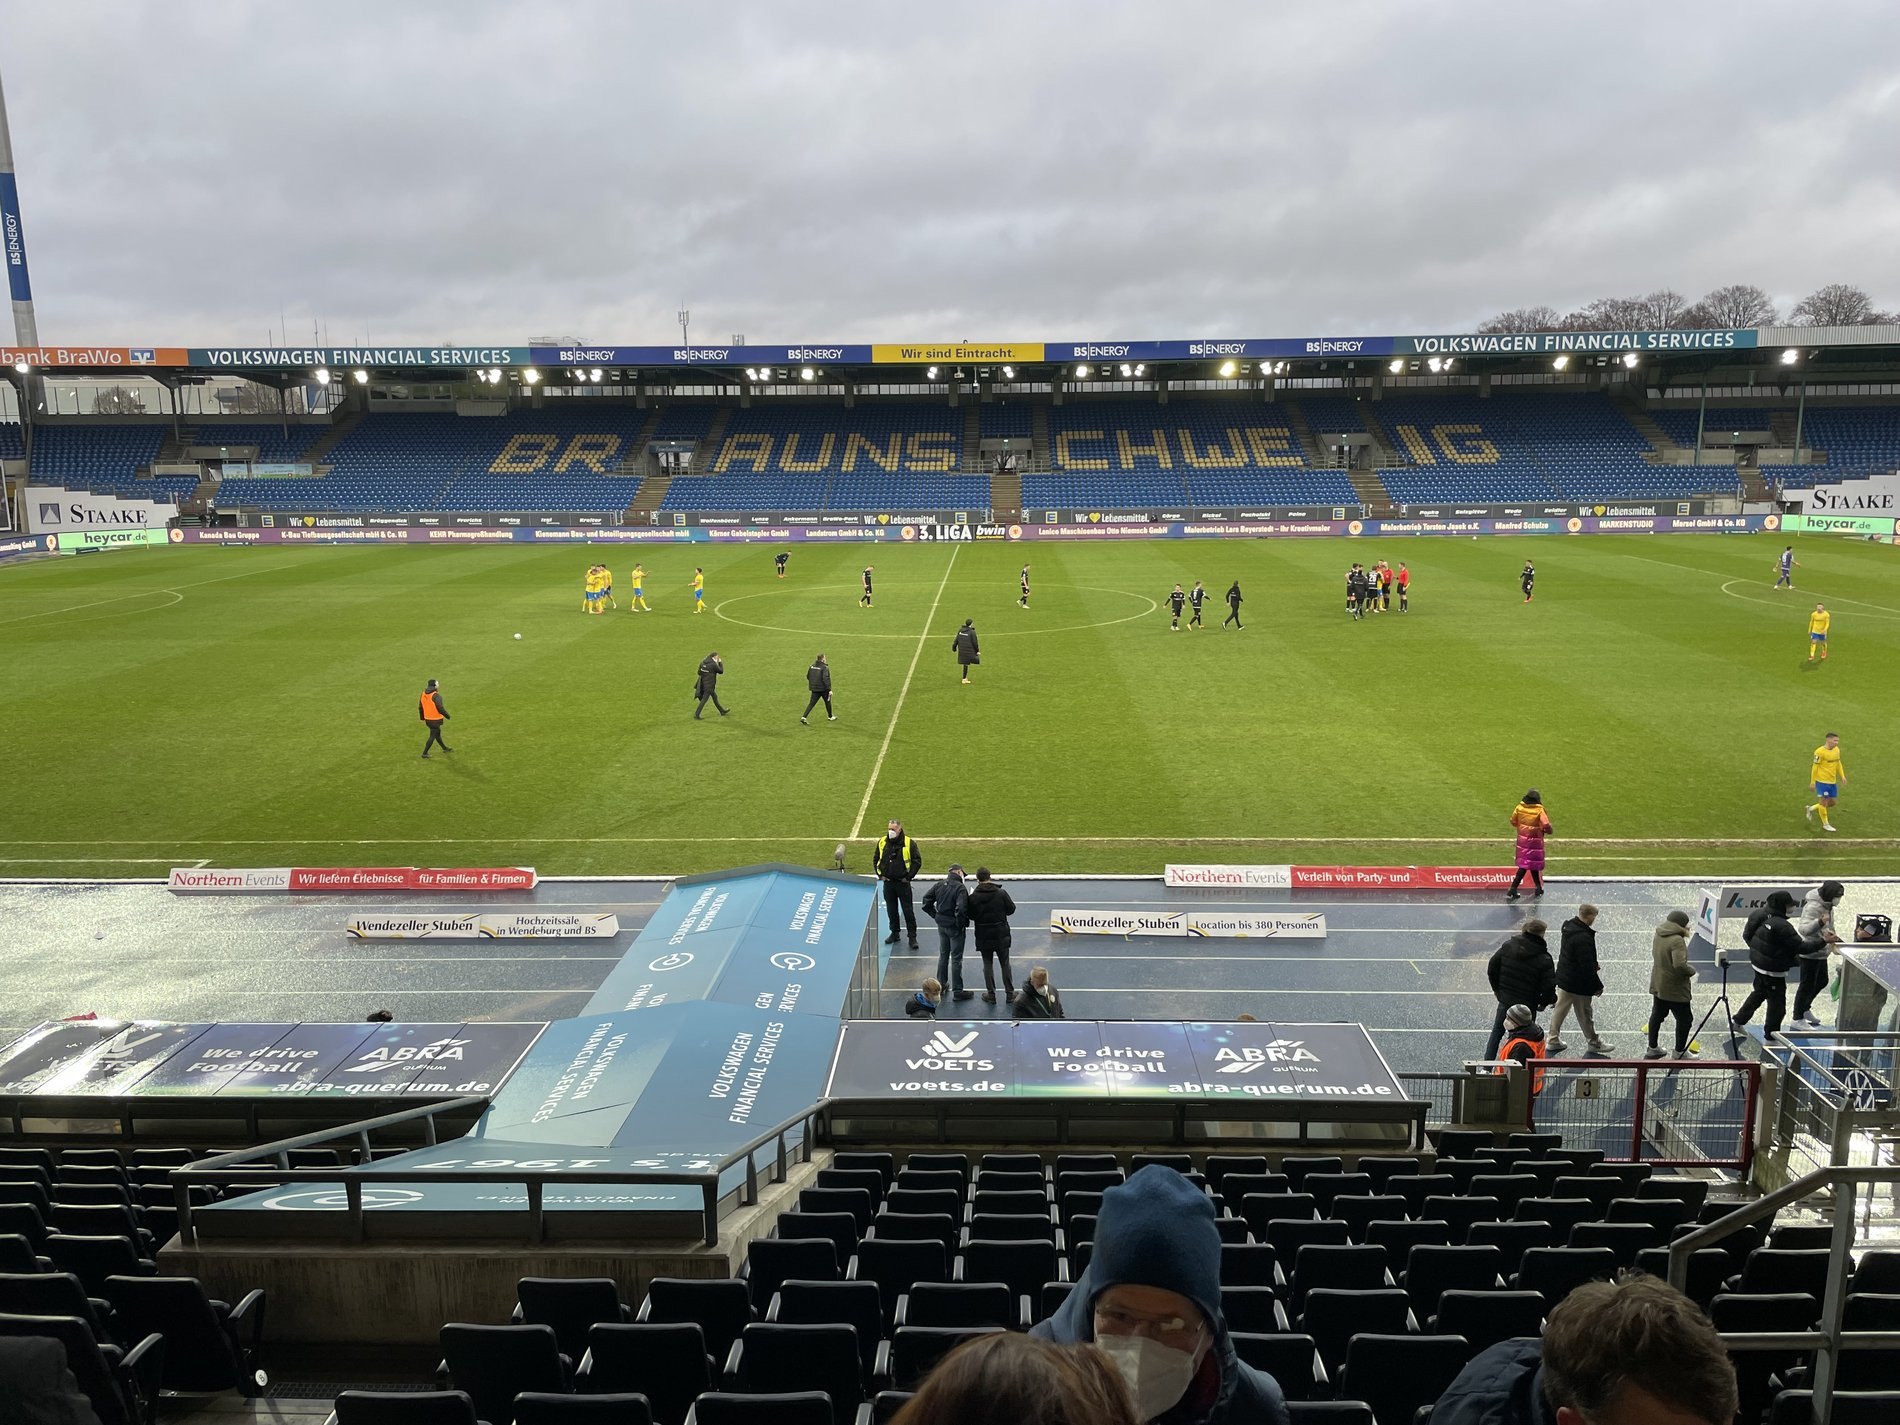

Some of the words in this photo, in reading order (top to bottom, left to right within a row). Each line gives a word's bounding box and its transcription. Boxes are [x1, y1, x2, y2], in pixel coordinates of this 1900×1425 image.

[1414, 335, 1536, 353] VOLKSWAGEN
[1544, 333, 1641, 350] FINANCIAL
[1647, 331, 1735, 348] SERVICES
[57, 349, 122, 364] BraWo
[207, 350, 326, 365] VOLKSWAGEN
[333, 350, 425, 364] FINANCIAL
[430, 349, 511, 364] SERVICES
[901, 348, 922, 358] Wir
[926, 348, 951, 358] sind
[955, 347, 1015, 358] Eintracht.
[1075, 514, 1088, 523] Wir
[1101, 513, 1150, 523] Lebensmittel.
[1579, 506, 1593, 516] Wir
[1606, 506, 1656, 516] Lebensmittel.
[290, 517, 303, 526] Wir
[316, 517, 364, 527] Lebensmittel.
[864, 515, 877, 525] Wir
[890, 515, 938, 525] Lebensmittel.
[1807, 517, 1871, 531] heycar.de
[919, 526, 934, 540] 3.
[936, 525, 972, 539] LIGA
[976, 525, 1006, 535] bwin
[174, 872, 243, 886] Northern
[245, 873, 286, 887] Events
[298, 874, 316, 886] Wir
[318, 873, 350, 885] liefern
[353, 873, 404, 884] Erlebnisse
[419, 873, 434, 886] für
[436, 873, 478, 884] Familien
[480, 874, 489, 884] &
[492, 873, 526, 884] Firmen
[1171, 869, 1243, 883] Northern
[1245, 870, 1287, 884] Events
[1297, 871, 1333, 883] Verleih
[1336, 874, 1354, 883] von
[1357, 872, 1387, 885] Party-
[1389, 872, 1410, 882] und
[789, 892, 816, 931] VOLKSWAGEN
[805, 912, 828, 945] FINANCIAL
[820, 886, 839, 916] SERVICES
[356, 919, 429, 932] Wendezeller
[432, 919, 473, 932] Stuben
[516, 916, 579, 926] Hochzeitssäle
[1060, 917, 1135, 930] Wendezeller
[1138, 917, 1179, 930] Stuben
[1195, 920, 1237, 930] Location
[1238, 920, 1252, 929] bis
[1254, 920, 1273, 930] 380
[1275, 920, 1319, 931] Personen
[497, 926, 506, 935] in
[508, 925, 561, 937] Wendeburg
[564, 925, 582, 935] und
[585, 926, 597, 935] BS
[778, 983, 802, 1013] RVICES
[202, 1047, 243, 1059] We
[250, 1046, 319, 1059] drive
[566, 1022, 613, 1073] FINANCIAL
[1047, 1046, 1088, 1059] We
[1096, 1045, 1165, 1059] drive
[1214, 1046, 1322, 1062] ABRA
[187, 1061, 304, 1074] Football
[570, 1032, 629, 1100] VOLKSWAGEN
[709, 1032, 754, 1099] VOLKSWAGEN
[905, 1058, 994, 1072] VOETS
[1052, 1060, 1167, 1074] Football
[729, 1065, 768, 1124] FINANCIAL
[759, 1021, 785, 1065] SERVICES
[272, 1079, 490, 1095] abra-querum.de
[890, 1079, 1006, 1093] voets.de
[1168, 1082, 1391, 1097] abra-querum.de
[1583, 1080, 1592, 1097] 3
[531, 1071, 579, 1124] SERVICES
